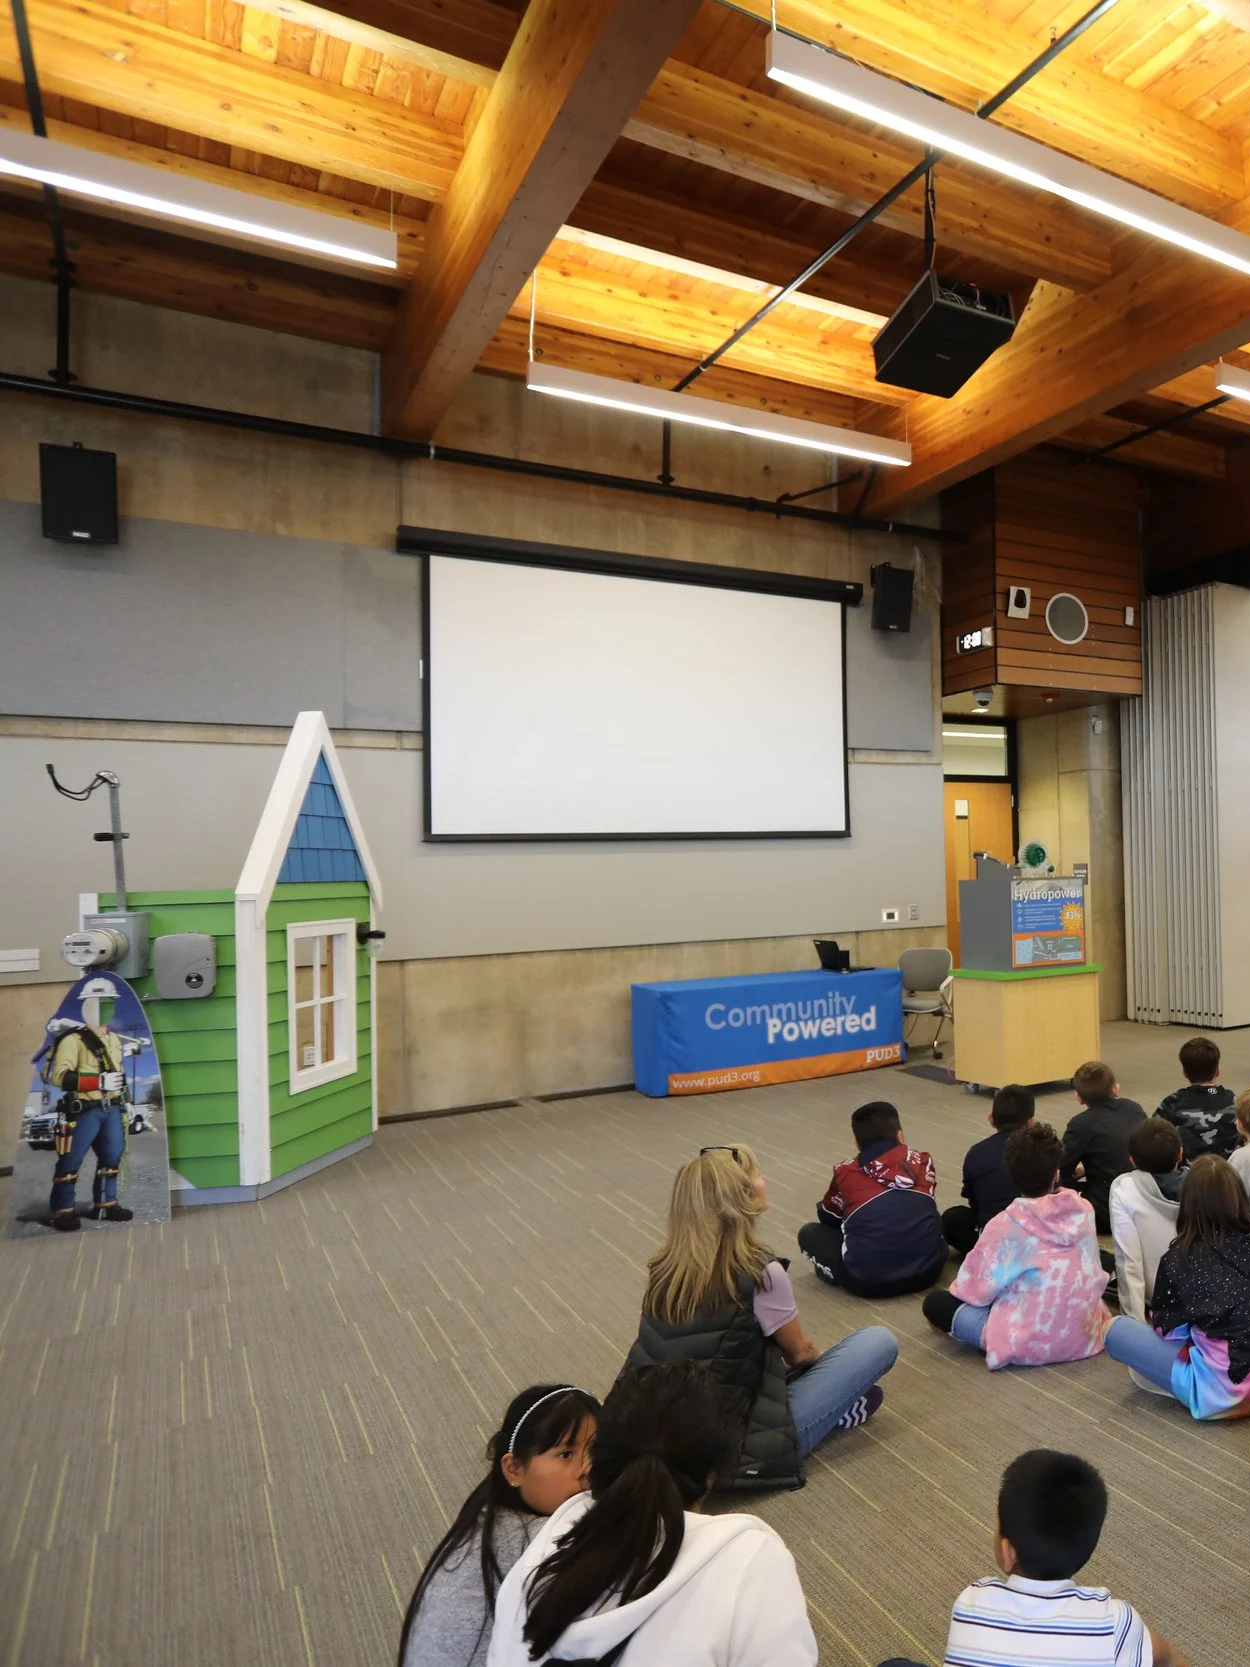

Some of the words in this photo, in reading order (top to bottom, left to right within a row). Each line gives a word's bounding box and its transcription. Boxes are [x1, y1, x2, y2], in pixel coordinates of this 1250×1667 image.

[1014, 889, 1081, 903] Hydropower
[705, 991, 857, 1030] Community
[767, 1005, 877, 1044] Powered
[866, 1045, 901, 1063] PUD3
[672, 1070, 761, 1089] www.pud3.org
